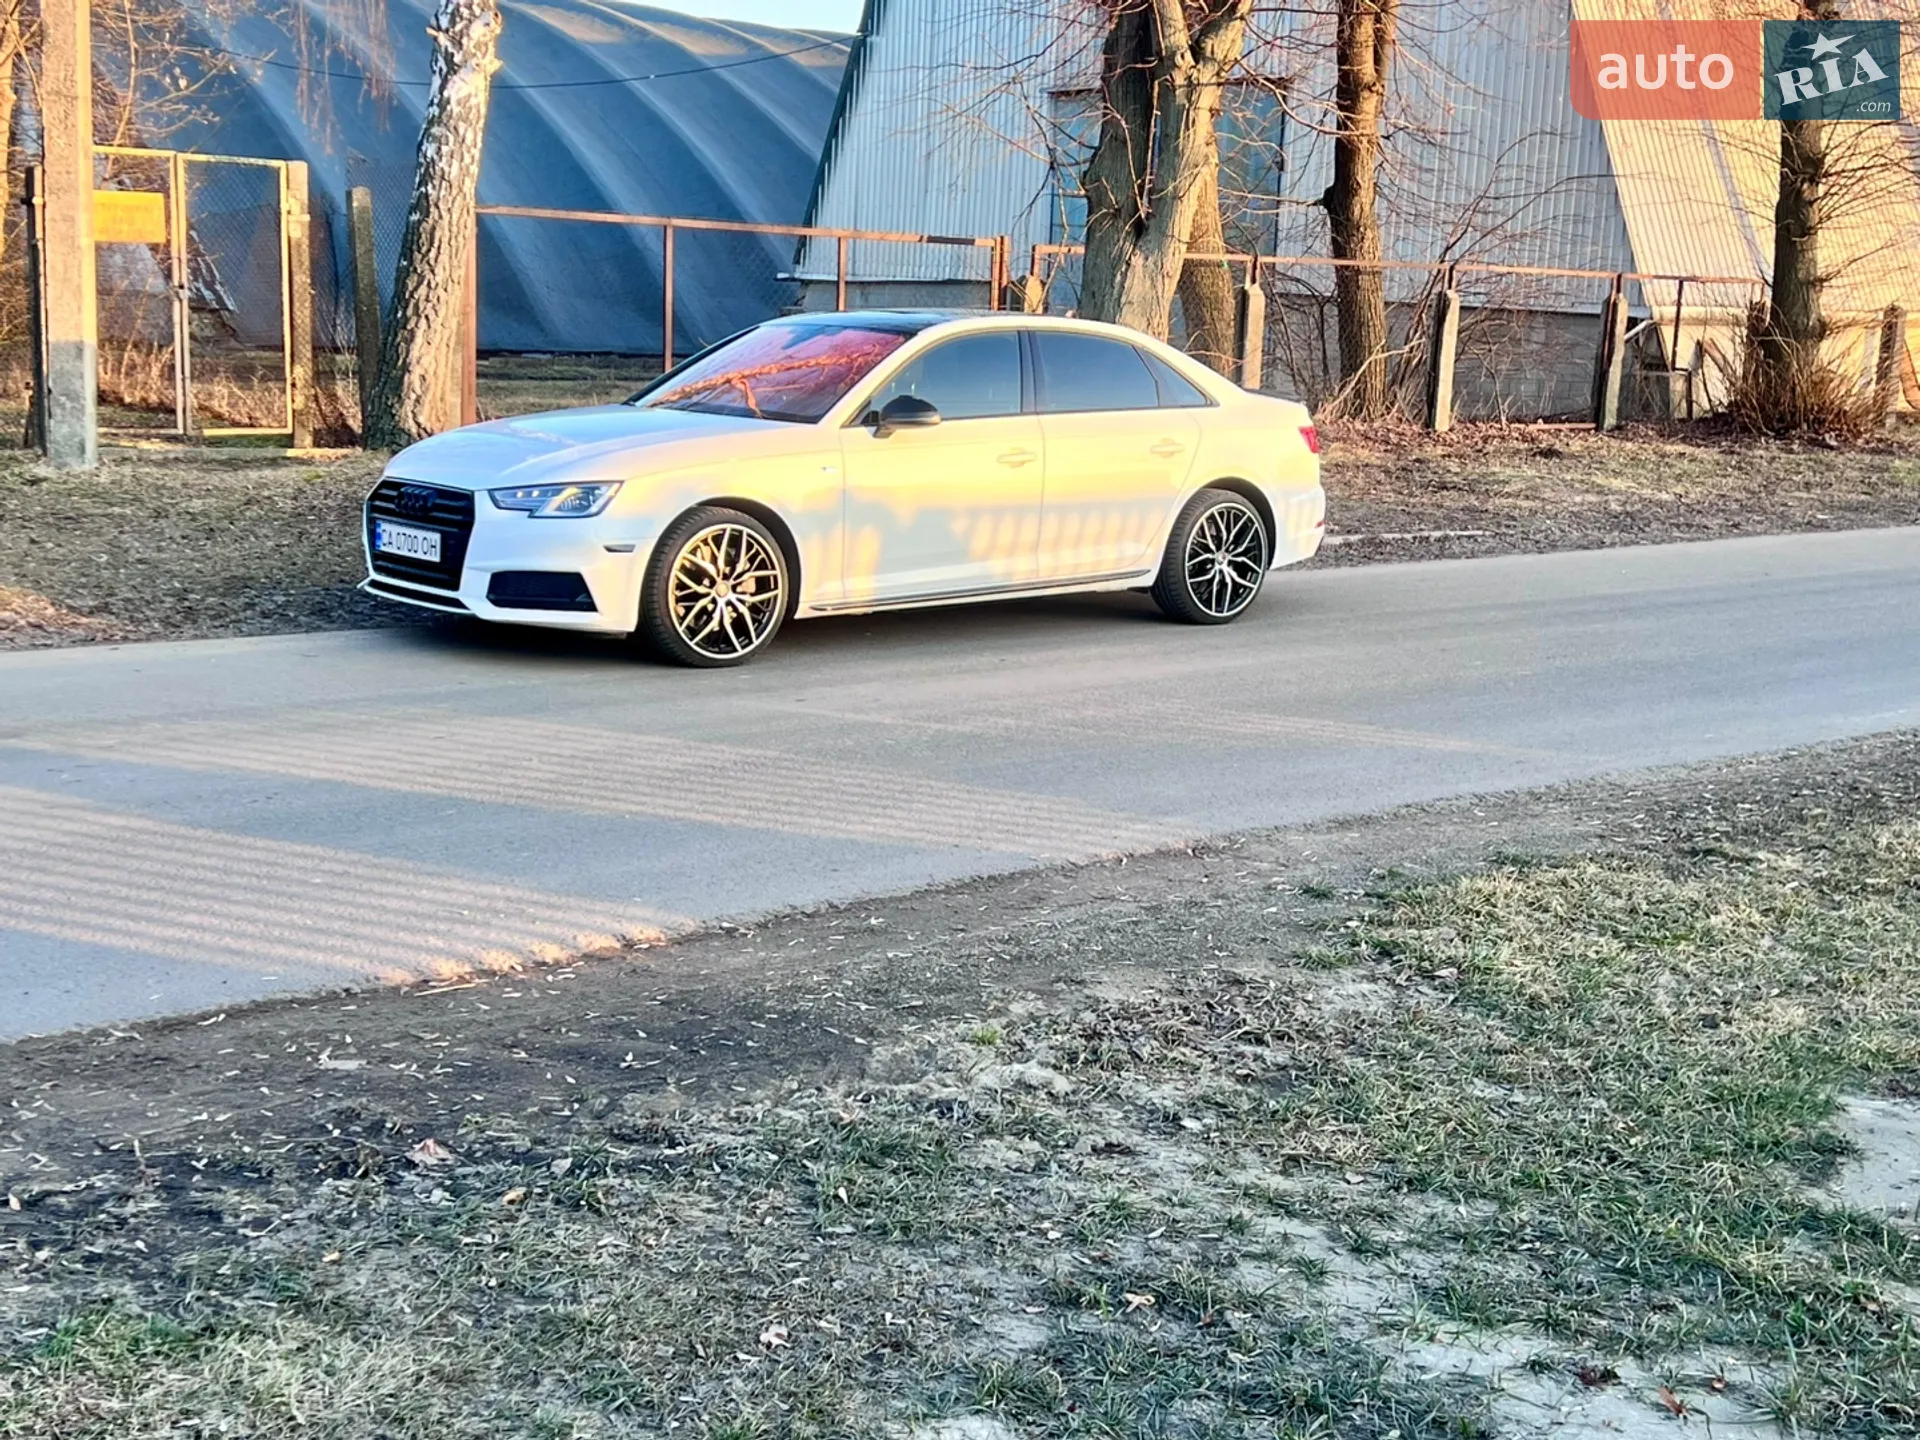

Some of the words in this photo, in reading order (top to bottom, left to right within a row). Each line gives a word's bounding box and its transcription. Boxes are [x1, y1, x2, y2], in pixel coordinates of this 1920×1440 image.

[381, 529, 395, 548] CA
[396, 532, 419, 553] 0700
[421, 537, 438, 557] OH
